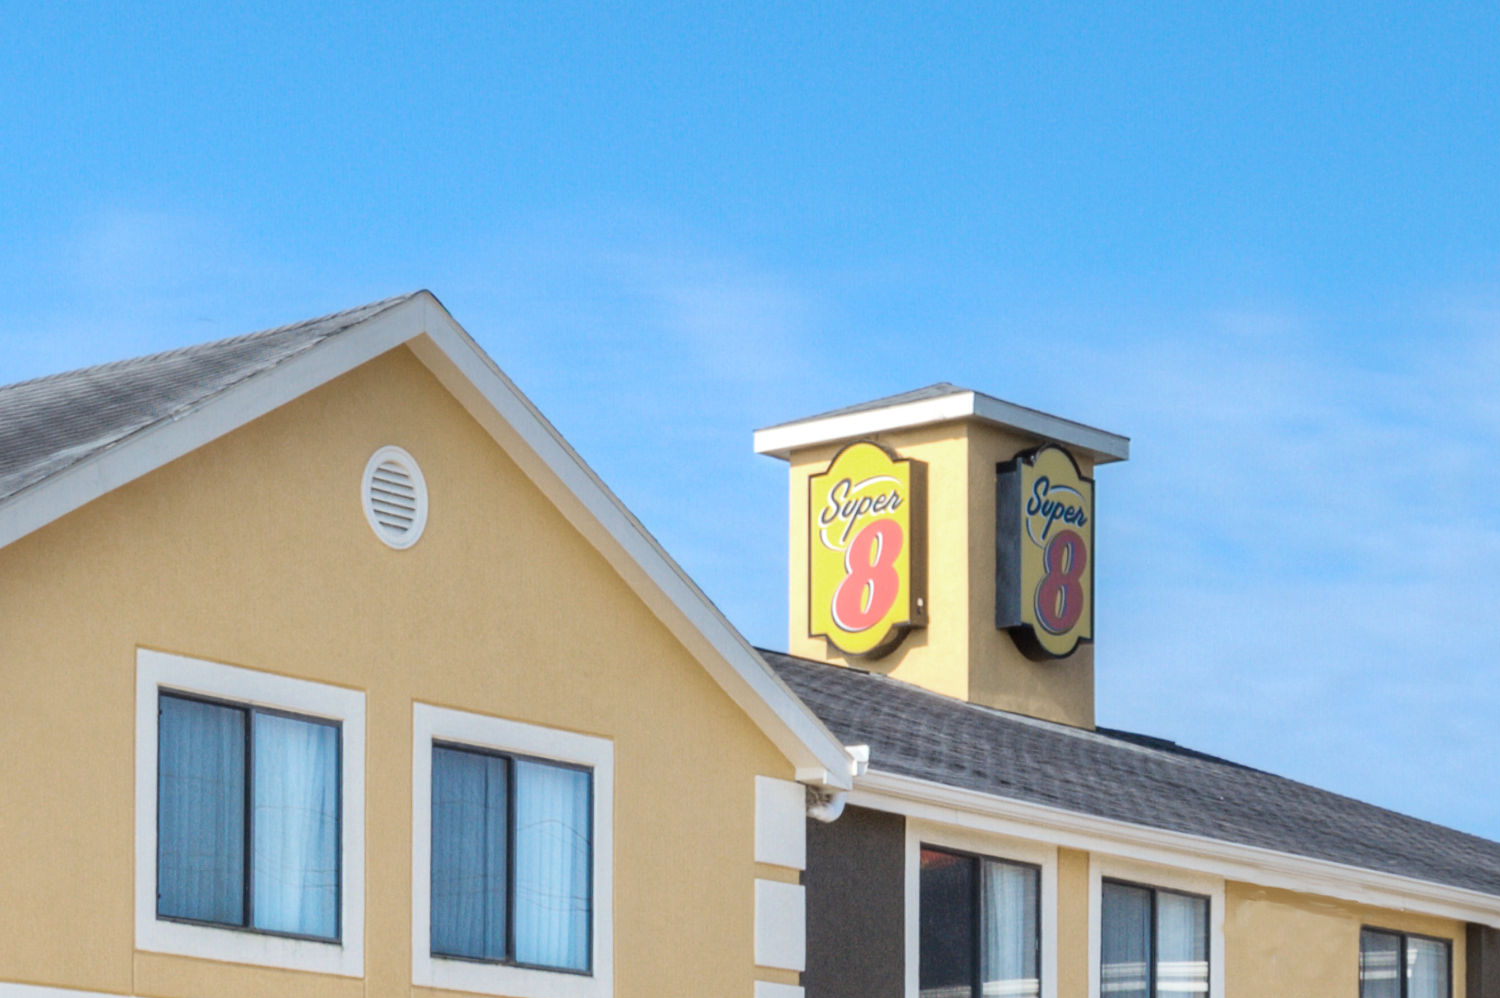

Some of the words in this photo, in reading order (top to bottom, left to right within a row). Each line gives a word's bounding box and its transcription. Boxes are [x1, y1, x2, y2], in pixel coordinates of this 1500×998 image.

[821, 478, 903, 543] Super
[1026, 475, 1088, 541] Super
[832, 519, 902, 632] 8
[1034, 529, 1088, 635] 8
